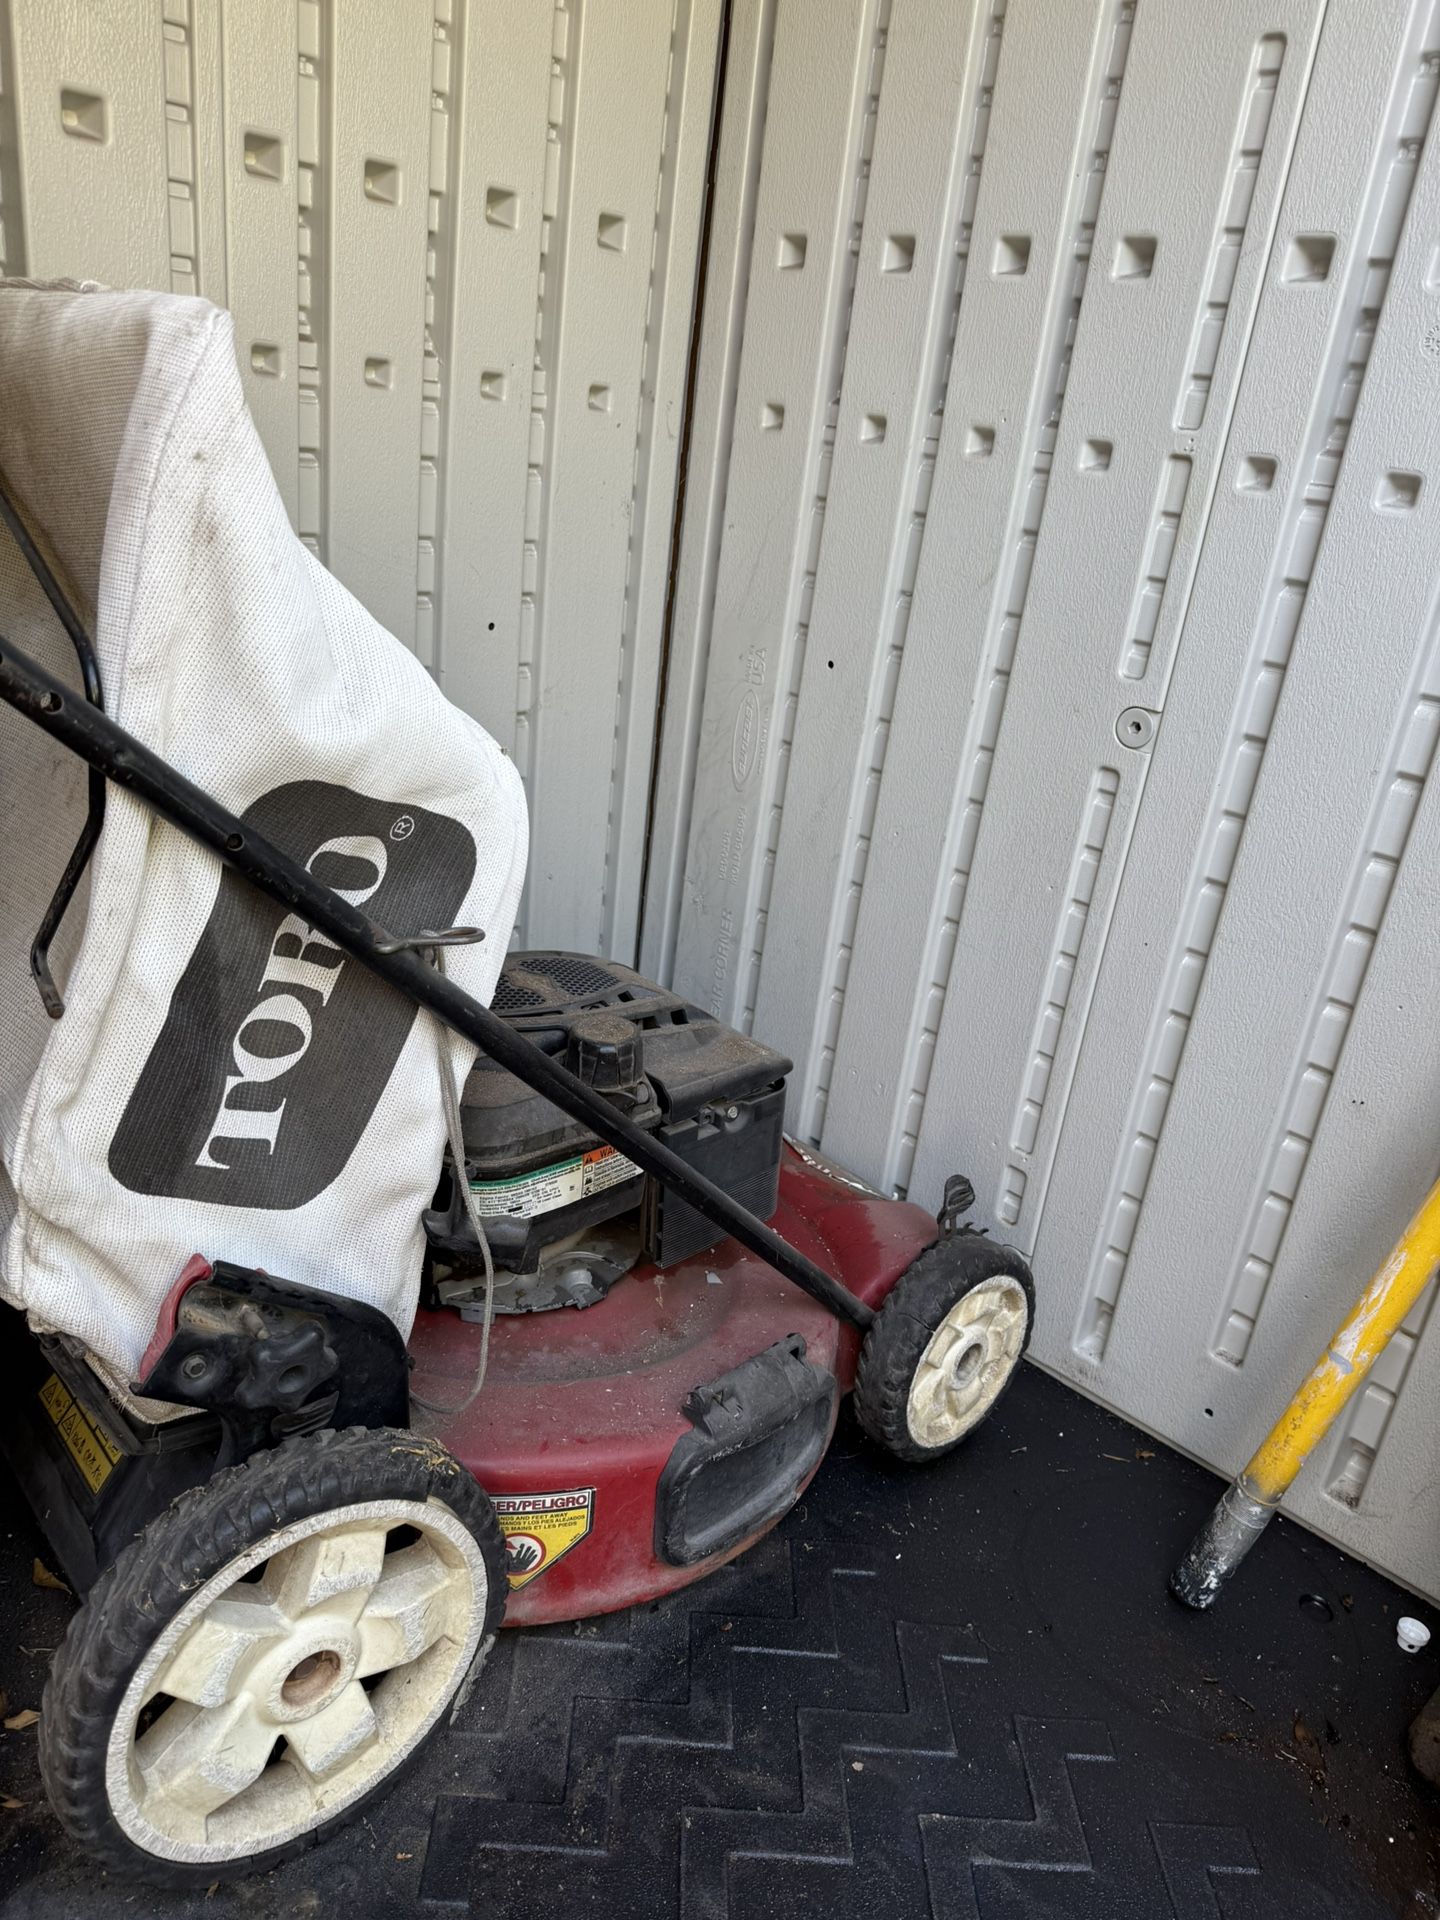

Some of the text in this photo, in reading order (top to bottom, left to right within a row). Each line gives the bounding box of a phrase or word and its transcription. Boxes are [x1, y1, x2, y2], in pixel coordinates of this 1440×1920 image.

[750, 647, 767, 686] USA
[708, 908, 733, 1017] EAR CORNER
[194, 834, 389, 1170] TORO
[555, 1514, 585, 1523] ALEJADOS
